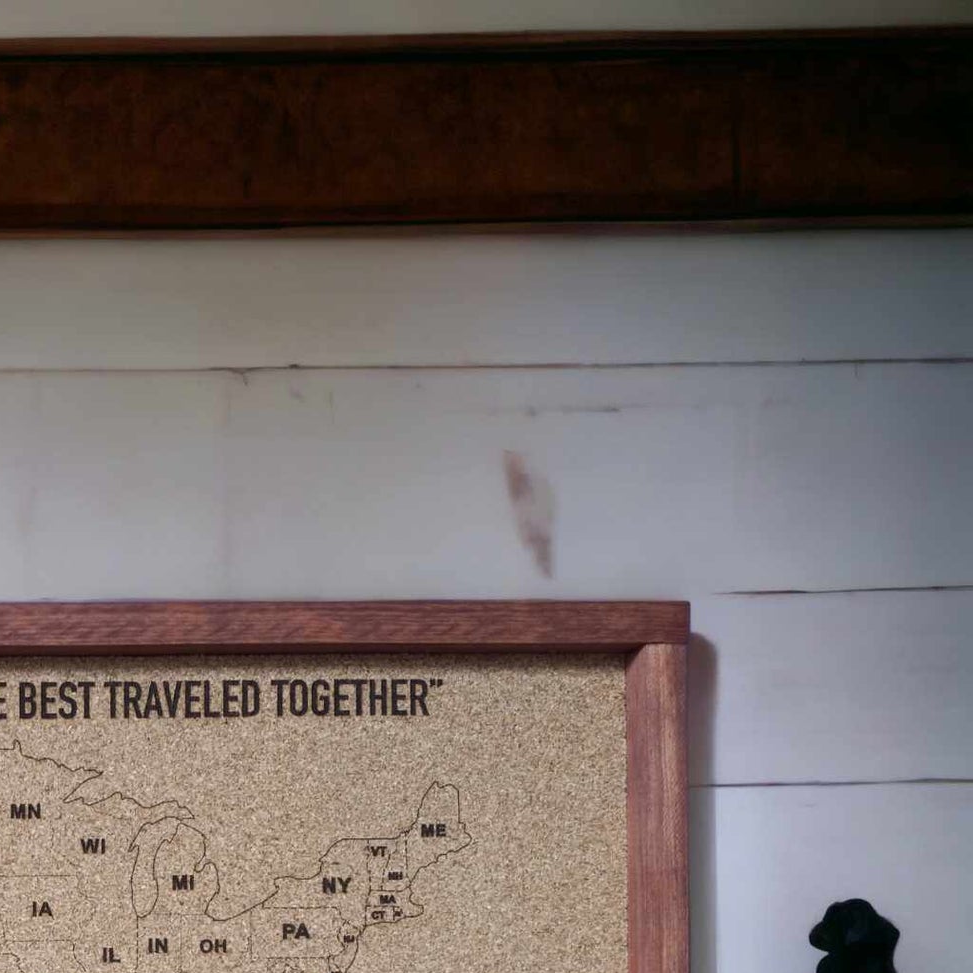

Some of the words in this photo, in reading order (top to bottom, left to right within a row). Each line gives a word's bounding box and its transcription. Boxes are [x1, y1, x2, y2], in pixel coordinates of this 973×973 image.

[18, 681, 96, 720] BEST
[103, 679, 261, 719] TRAVELED
[10, 803, 41, 820] MN
[420, 823, 447, 838] ME
[80, 838, 106, 854] WI
[370, 846, 387, 857] VT
[172, 874, 194, 891] MI
[322, 877, 352, 894] NY
[32, 901, 53, 917] IA
[371, 910, 385, 920] CT
[282, 923, 310, 940] PA
[148, 938, 168, 954] IN
[199, 939, 227, 954] OH
[102, 947, 121, 963] IL
